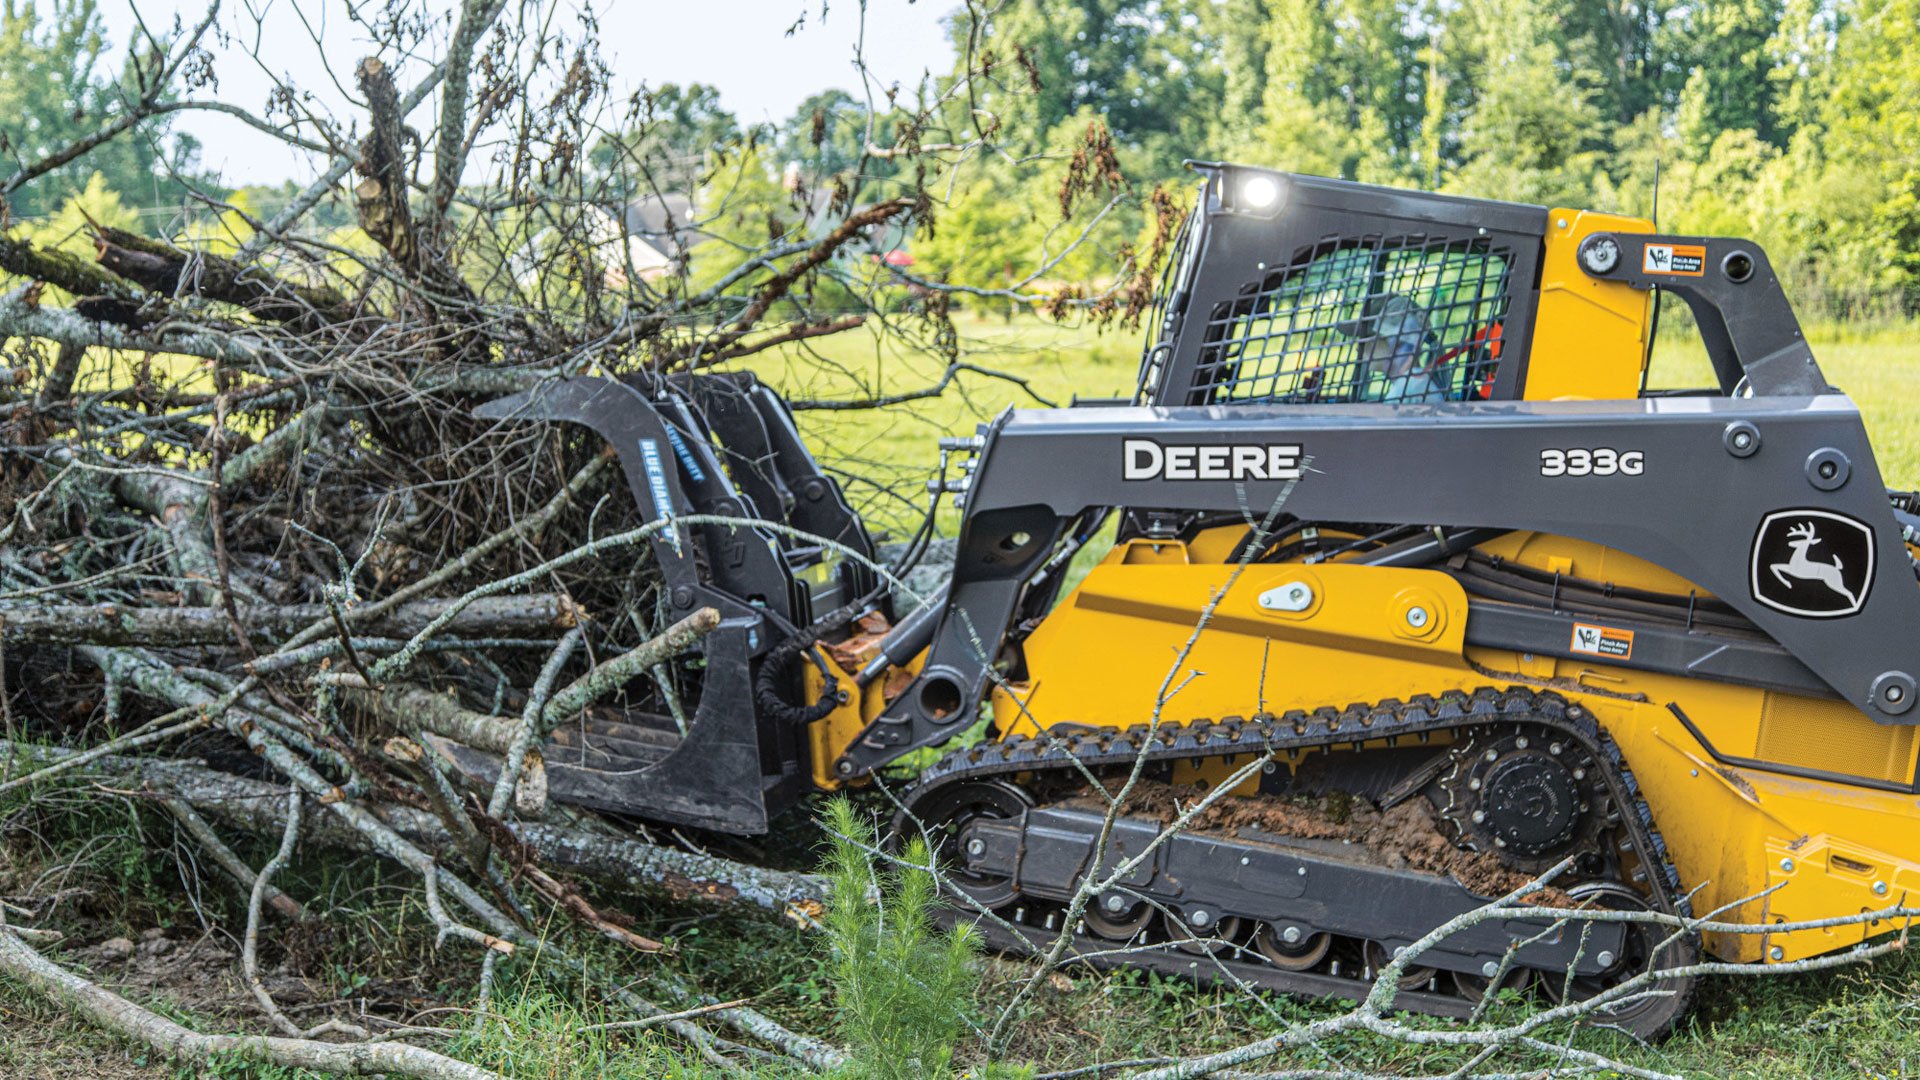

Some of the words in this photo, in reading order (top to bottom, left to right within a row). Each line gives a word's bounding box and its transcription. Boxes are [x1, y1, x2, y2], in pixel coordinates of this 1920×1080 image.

[641, 440, 661, 474] BLUE
[1124, 440, 1301, 480] DEERE
[1541, 448, 1645, 477] 333G
[650, 474, 675, 539] DIAMOD
